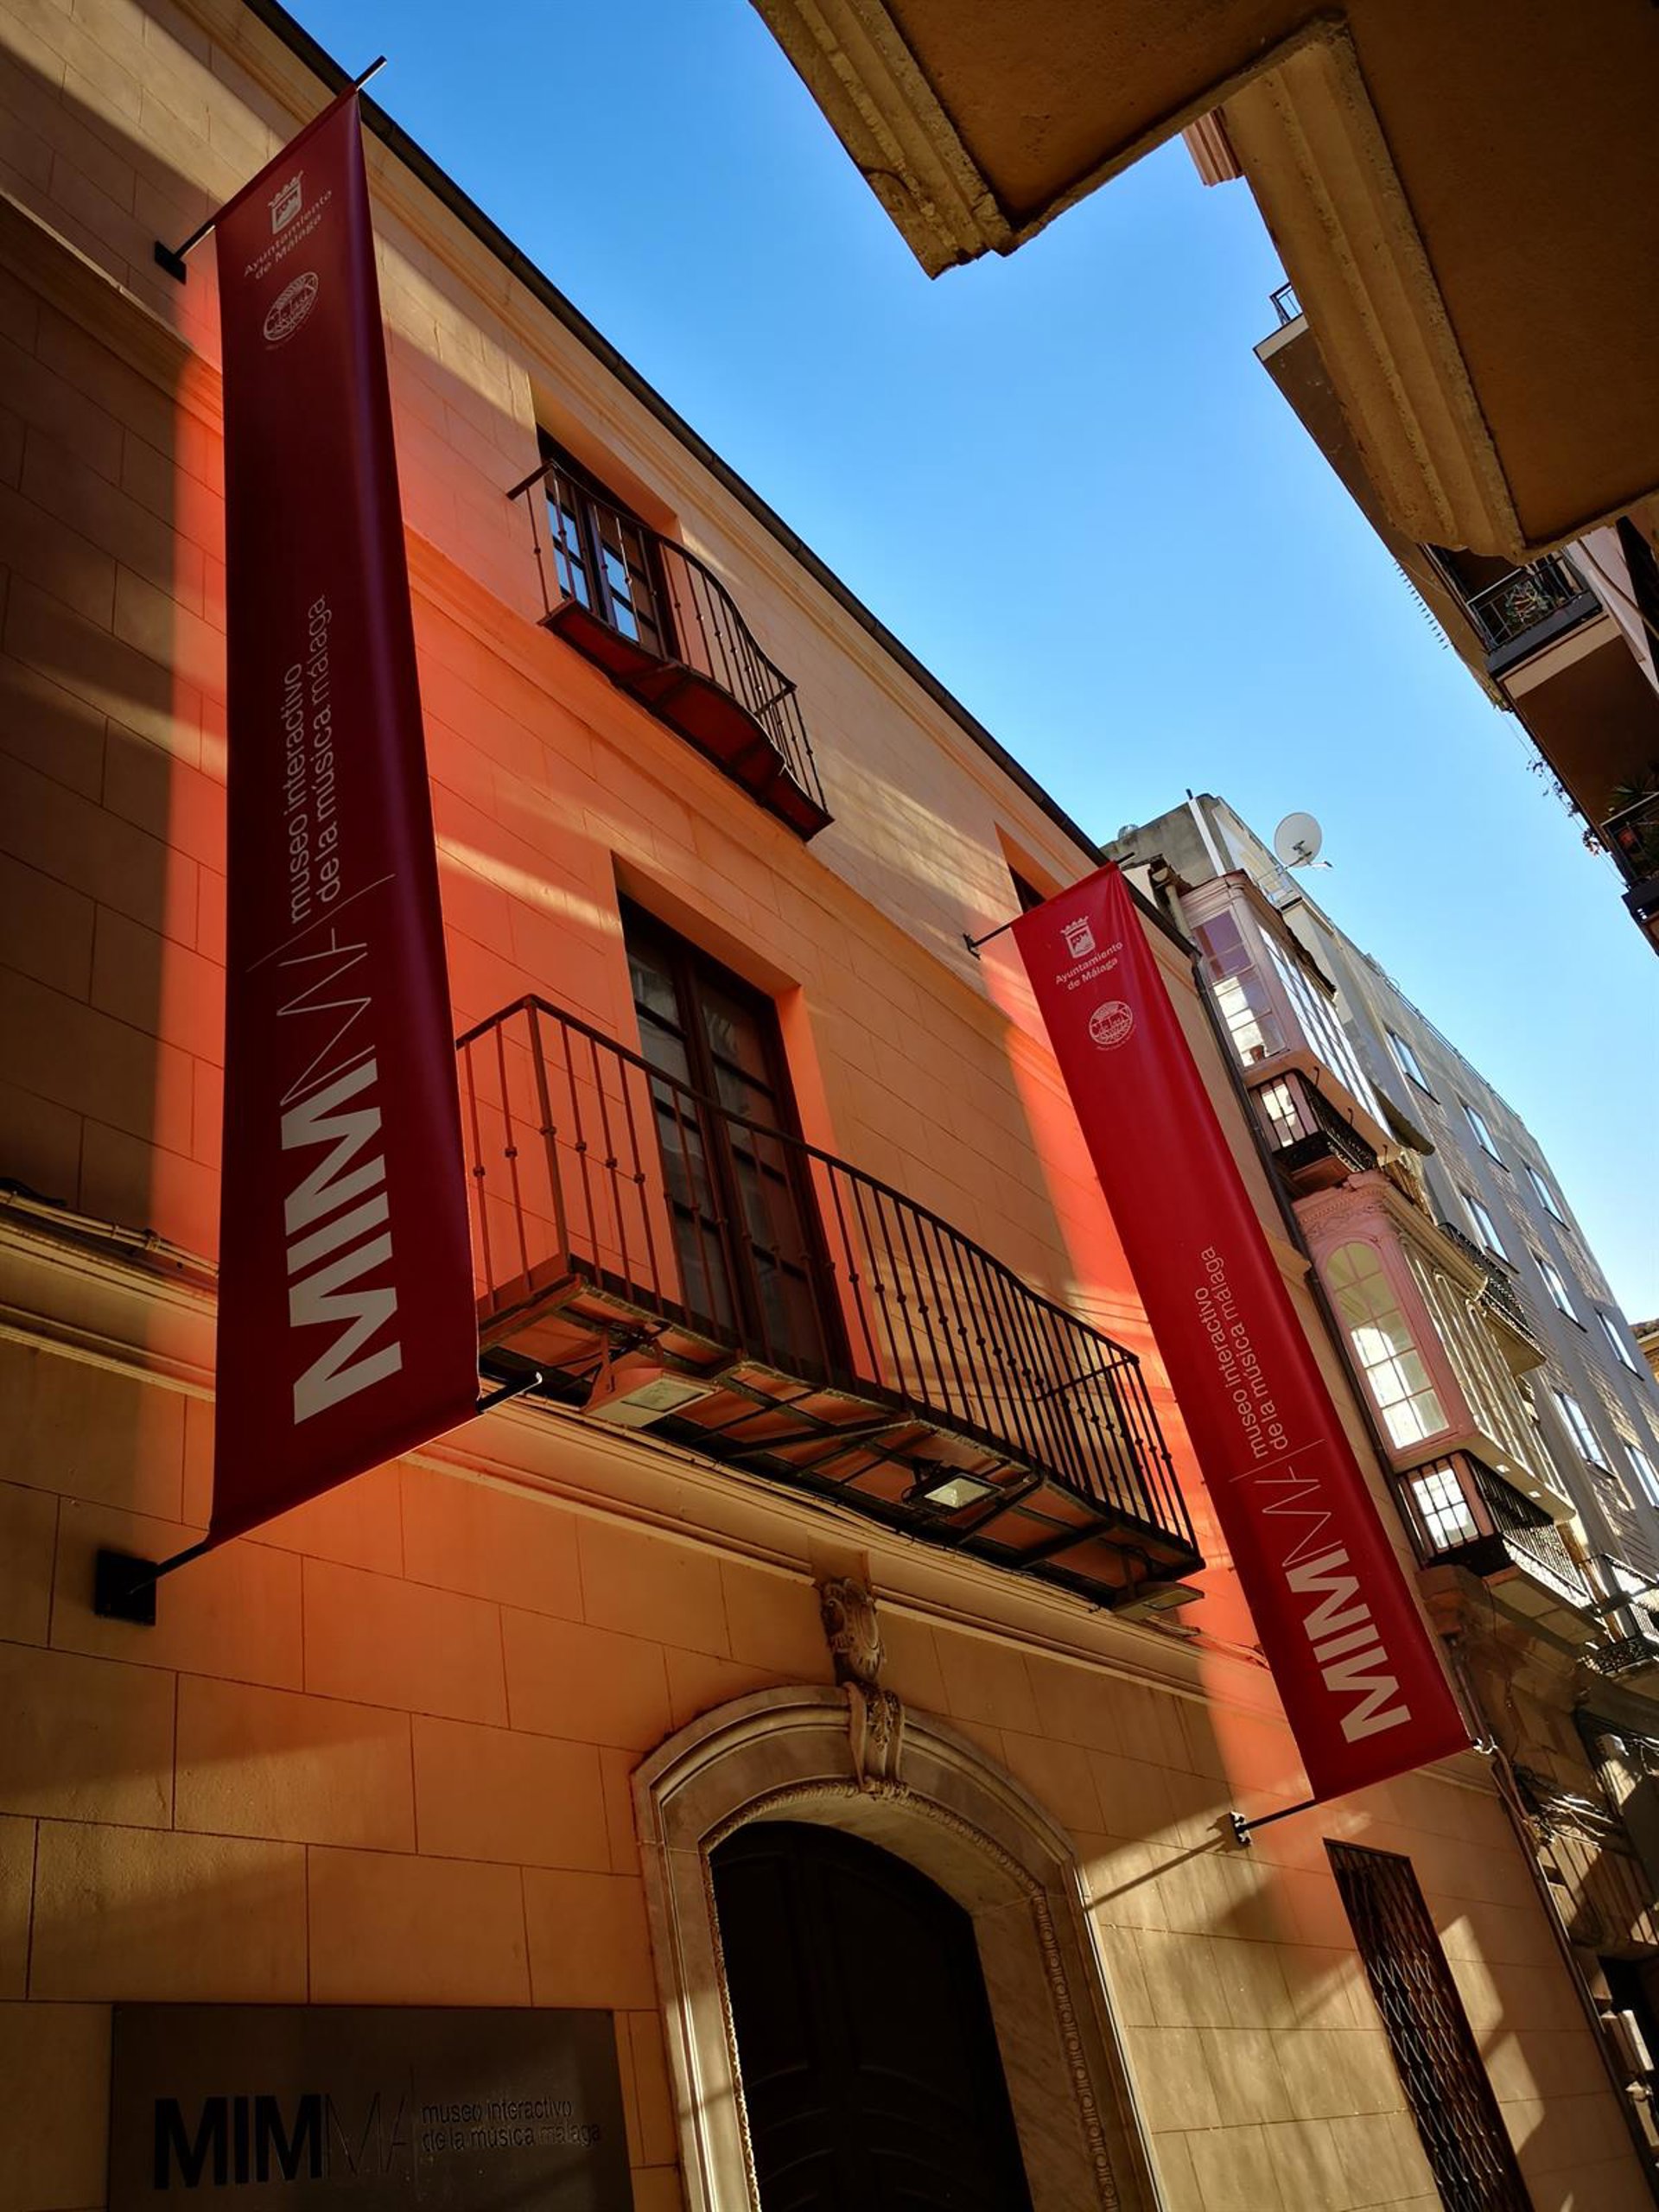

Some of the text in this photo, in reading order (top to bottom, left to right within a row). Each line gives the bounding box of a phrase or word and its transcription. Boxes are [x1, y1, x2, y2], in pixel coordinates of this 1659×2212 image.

[281, 664, 311, 924] museo interactivo
[308, 593, 340, 902] de la música málaga
[1055, 941, 1123, 985] Ayuntamiento
[1068, 957, 1118, 991] de Málaga
[1195, 1287, 1268, 1459] museo interactivo
[1201, 1246, 1288, 1450] de la música málaga
[422, 2094, 572, 2124] museo interactivo
[423, 2129, 446, 2152] de
[449, 2128, 465, 2150] la
